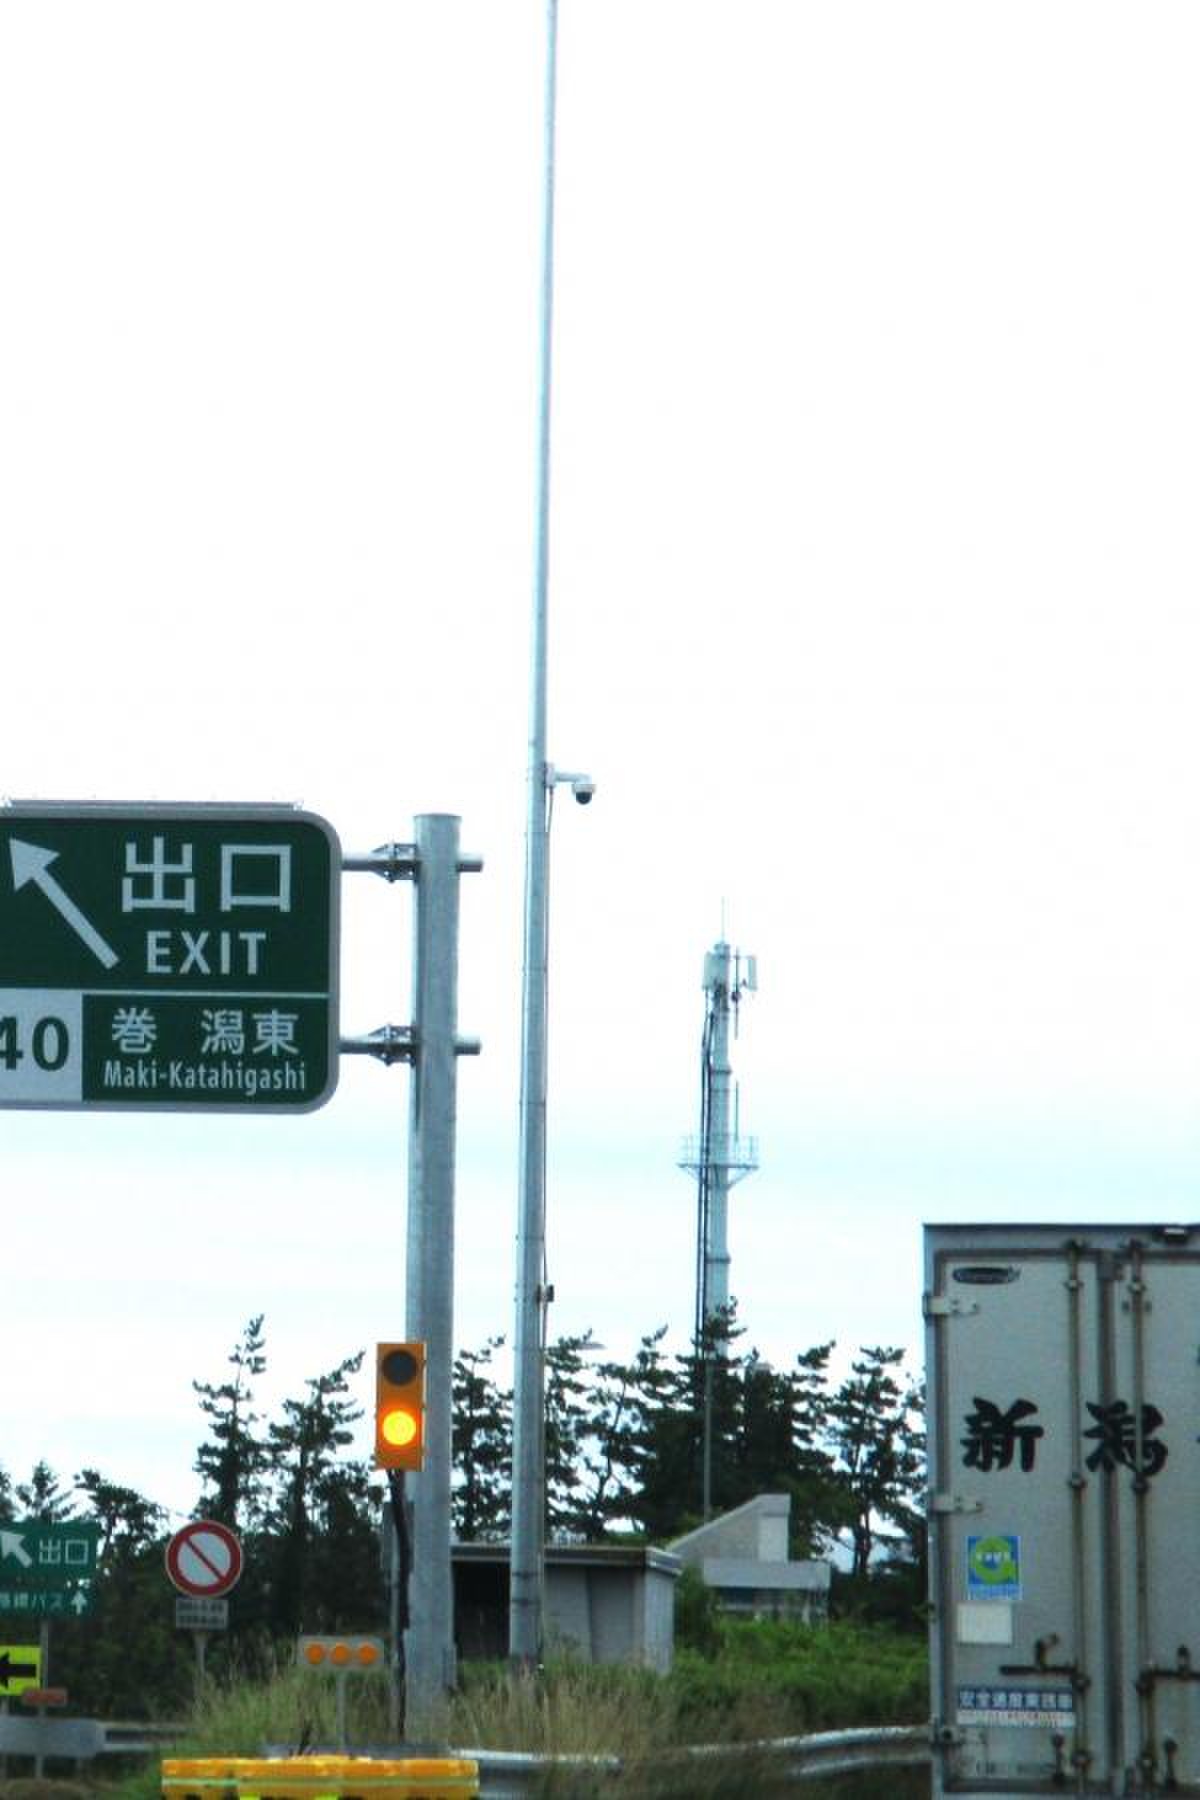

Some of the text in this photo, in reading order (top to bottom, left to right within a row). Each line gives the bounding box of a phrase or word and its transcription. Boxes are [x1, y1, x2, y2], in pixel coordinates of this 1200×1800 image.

[121, 836, 292, 913] 出口
[146, 931, 267, 975] EXIT
[111, 1006, 299, 1057] 巻 潟東
[104, 1059, 306, 1096] Maki-Katahigashi
[38, 1538, 89, 1565] 出口
